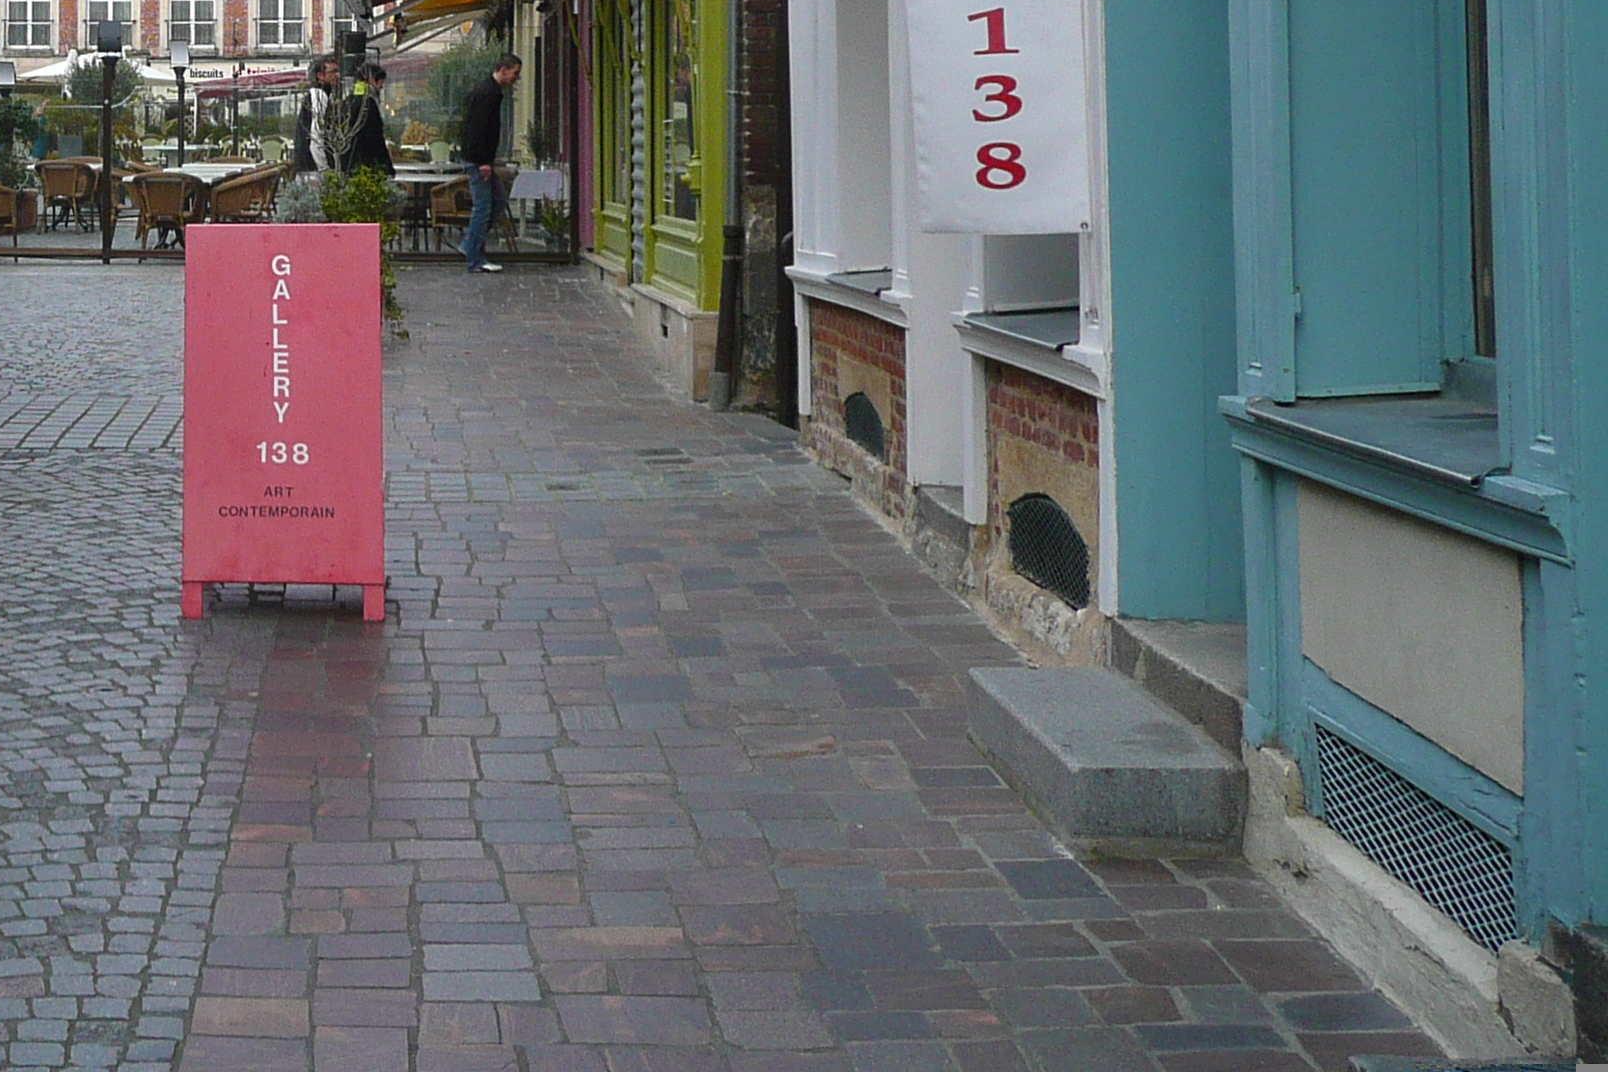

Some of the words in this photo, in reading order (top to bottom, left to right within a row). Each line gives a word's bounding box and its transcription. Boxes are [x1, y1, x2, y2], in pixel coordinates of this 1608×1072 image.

[189, 67, 224, 79] biscuits
[967, 7, 1027, 191] 138
[271, 254, 291, 423] GALLERY
[256, 441, 310, 465] 138
[263, 486, 294, 498] ART
[218, 505, 335, 518] CONTEMPORAIN
